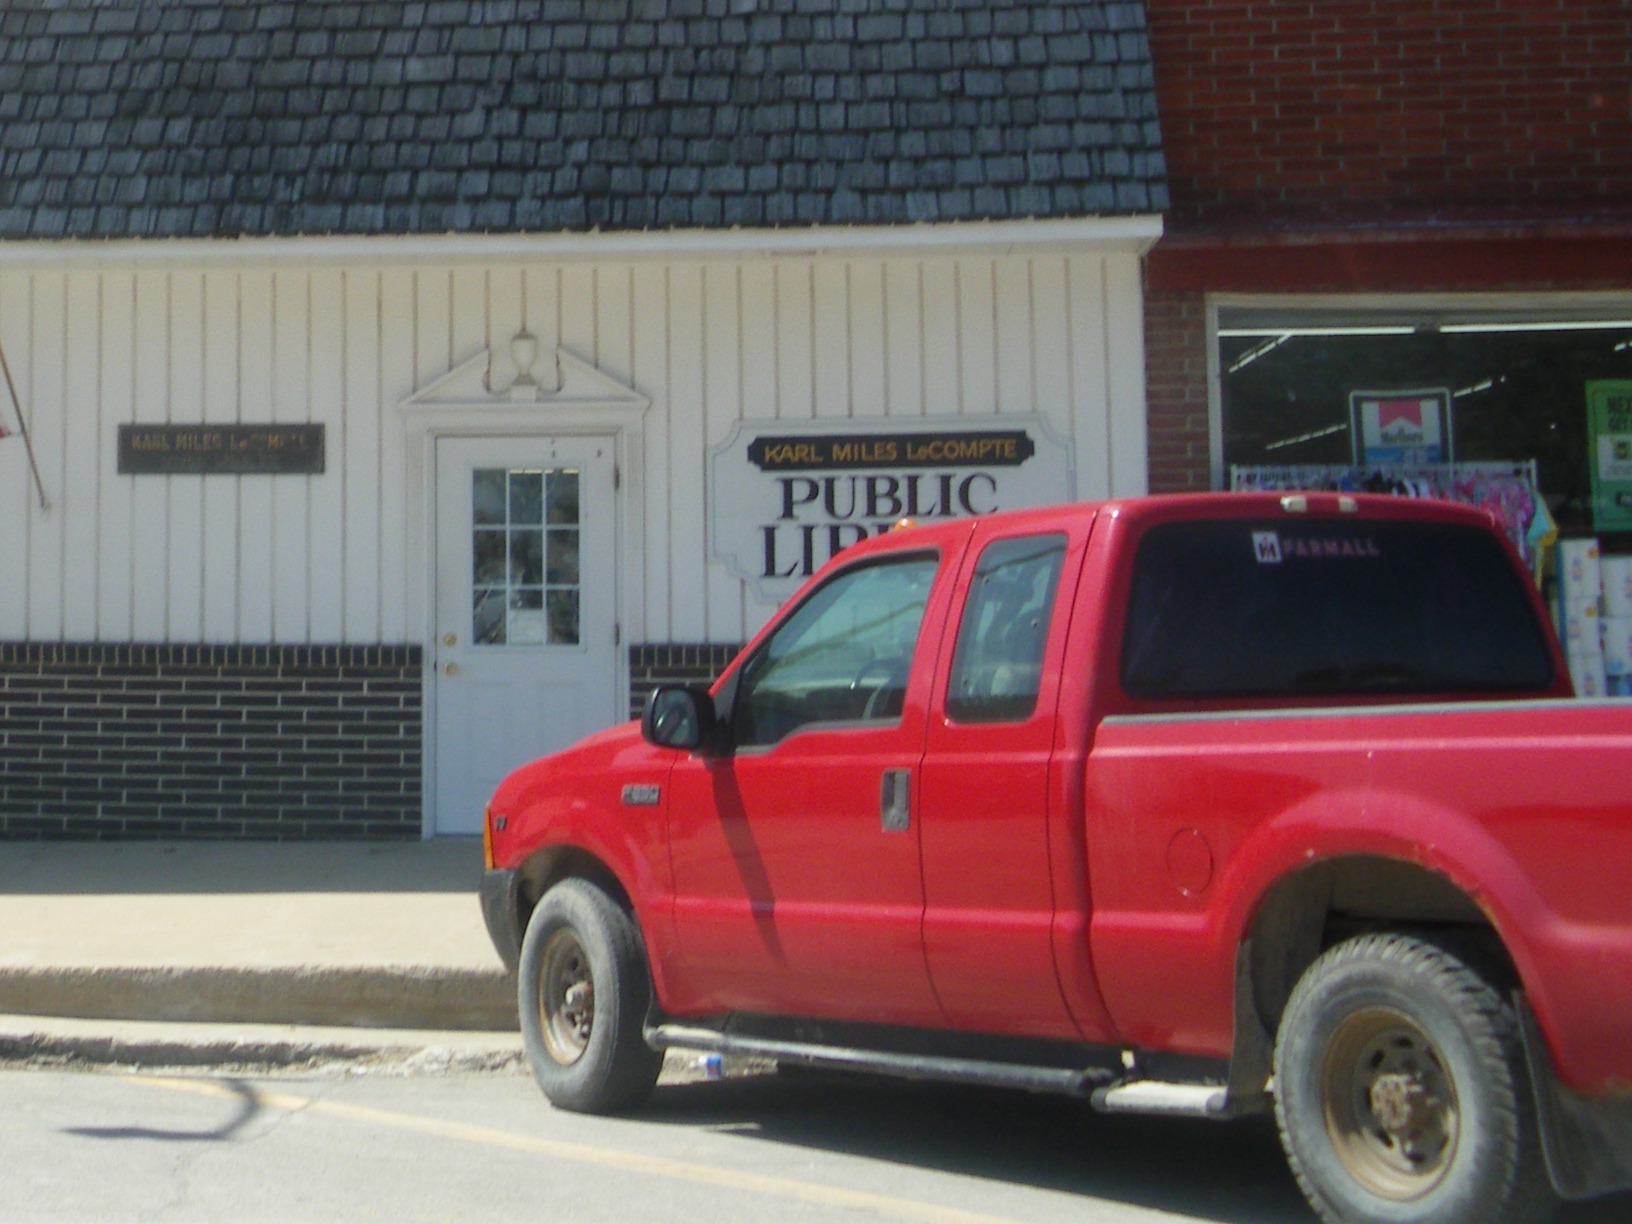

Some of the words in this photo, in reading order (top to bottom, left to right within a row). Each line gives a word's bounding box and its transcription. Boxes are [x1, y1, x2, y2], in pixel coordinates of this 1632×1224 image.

[764, 443, 823, 464] KARL
[831, 442, 897, 462] MILES
[906, 438, 1017, 461] LeCOMPTE
[776, 472, 1000, 521] PUBLIC
